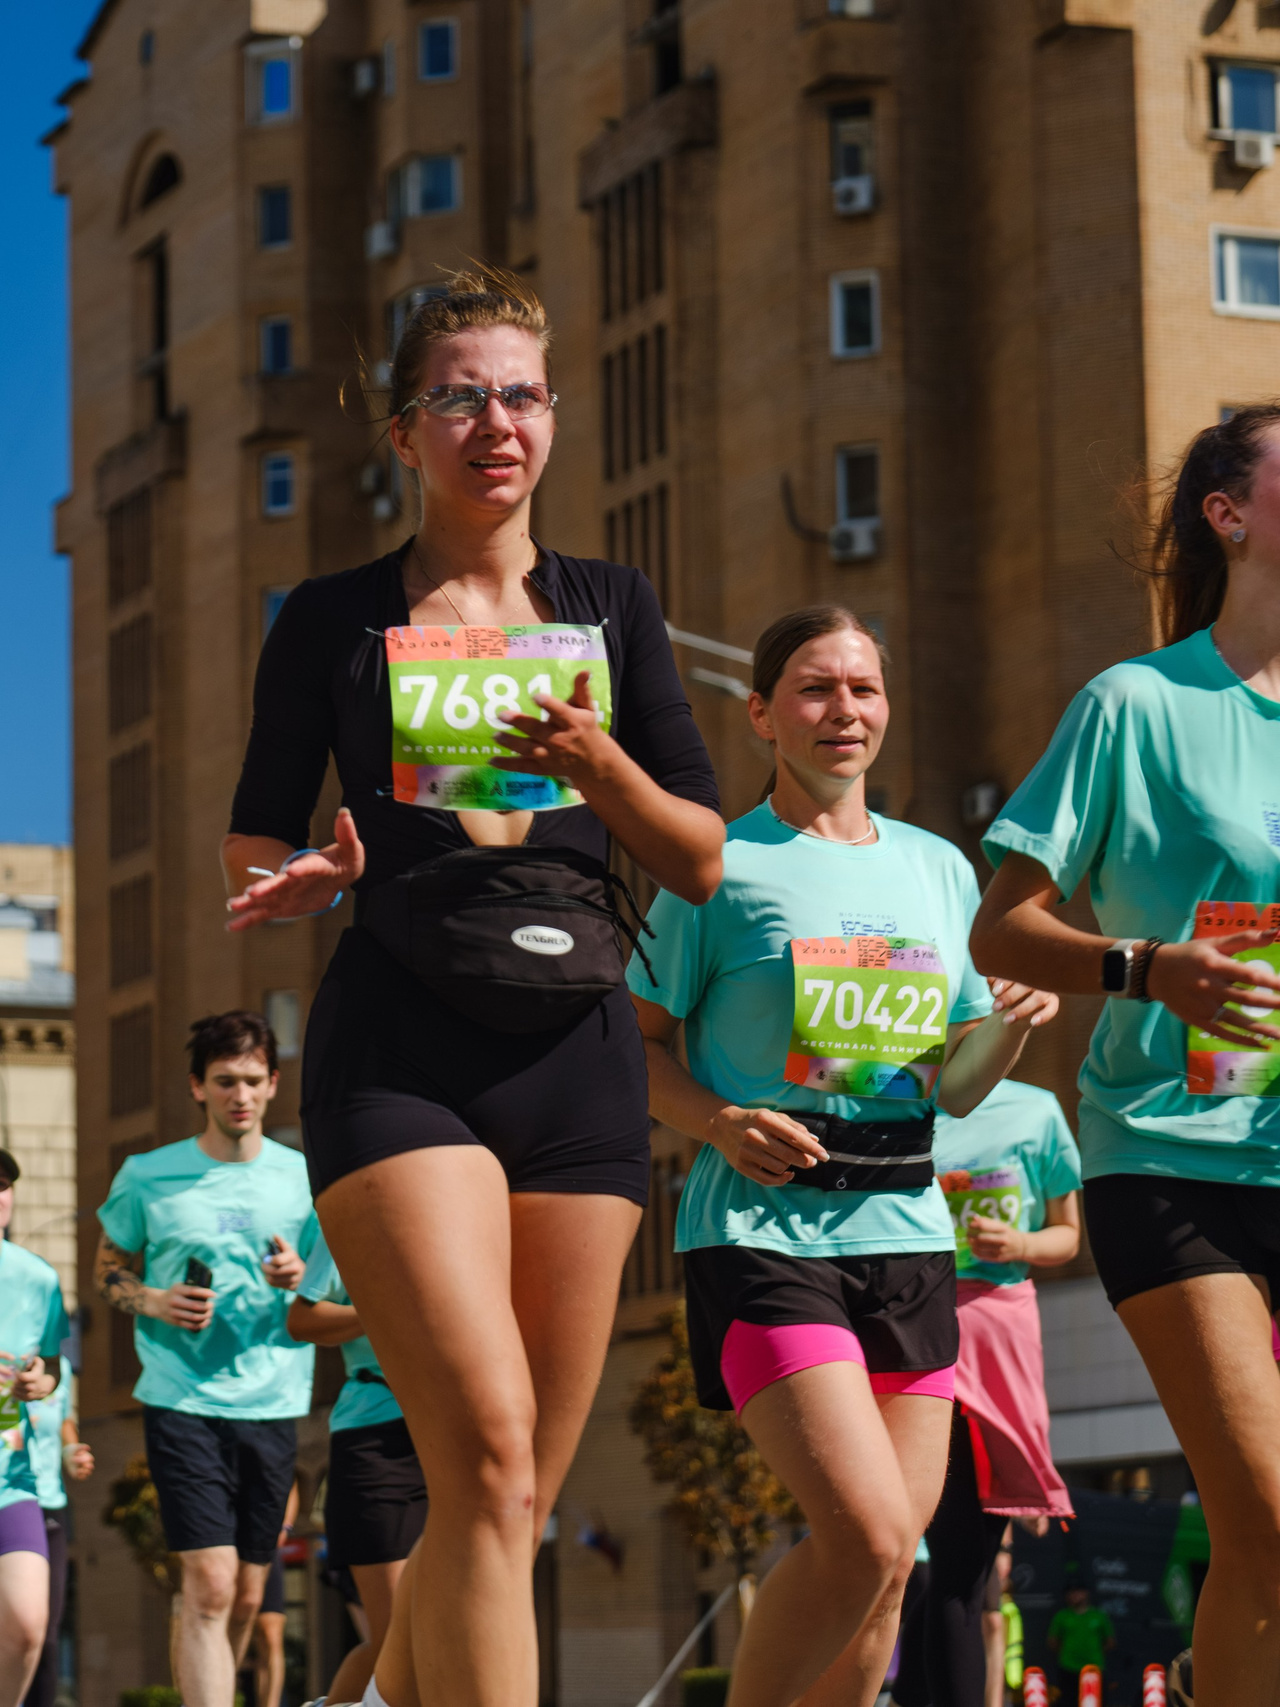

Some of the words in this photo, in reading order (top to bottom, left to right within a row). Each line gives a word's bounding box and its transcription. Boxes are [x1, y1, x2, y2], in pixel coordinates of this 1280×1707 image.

[541, 635, 553, 645] 5
[398, 673, 606, 730] 7681
[401, 745, 502, 755] ФЕСТИВАЛЬ
[1204, 917, 1258, 927] 23/08
[802, 946, 848, 955] 23/08
[912, 949, 920, 958] 5
[803, 979, 943, 1036] 70422
[800, 1039, 876, 1051] ФЕСТИВАЛЬ
[882, 1045, 940, 1056] ДВИЖЕНИЯ
